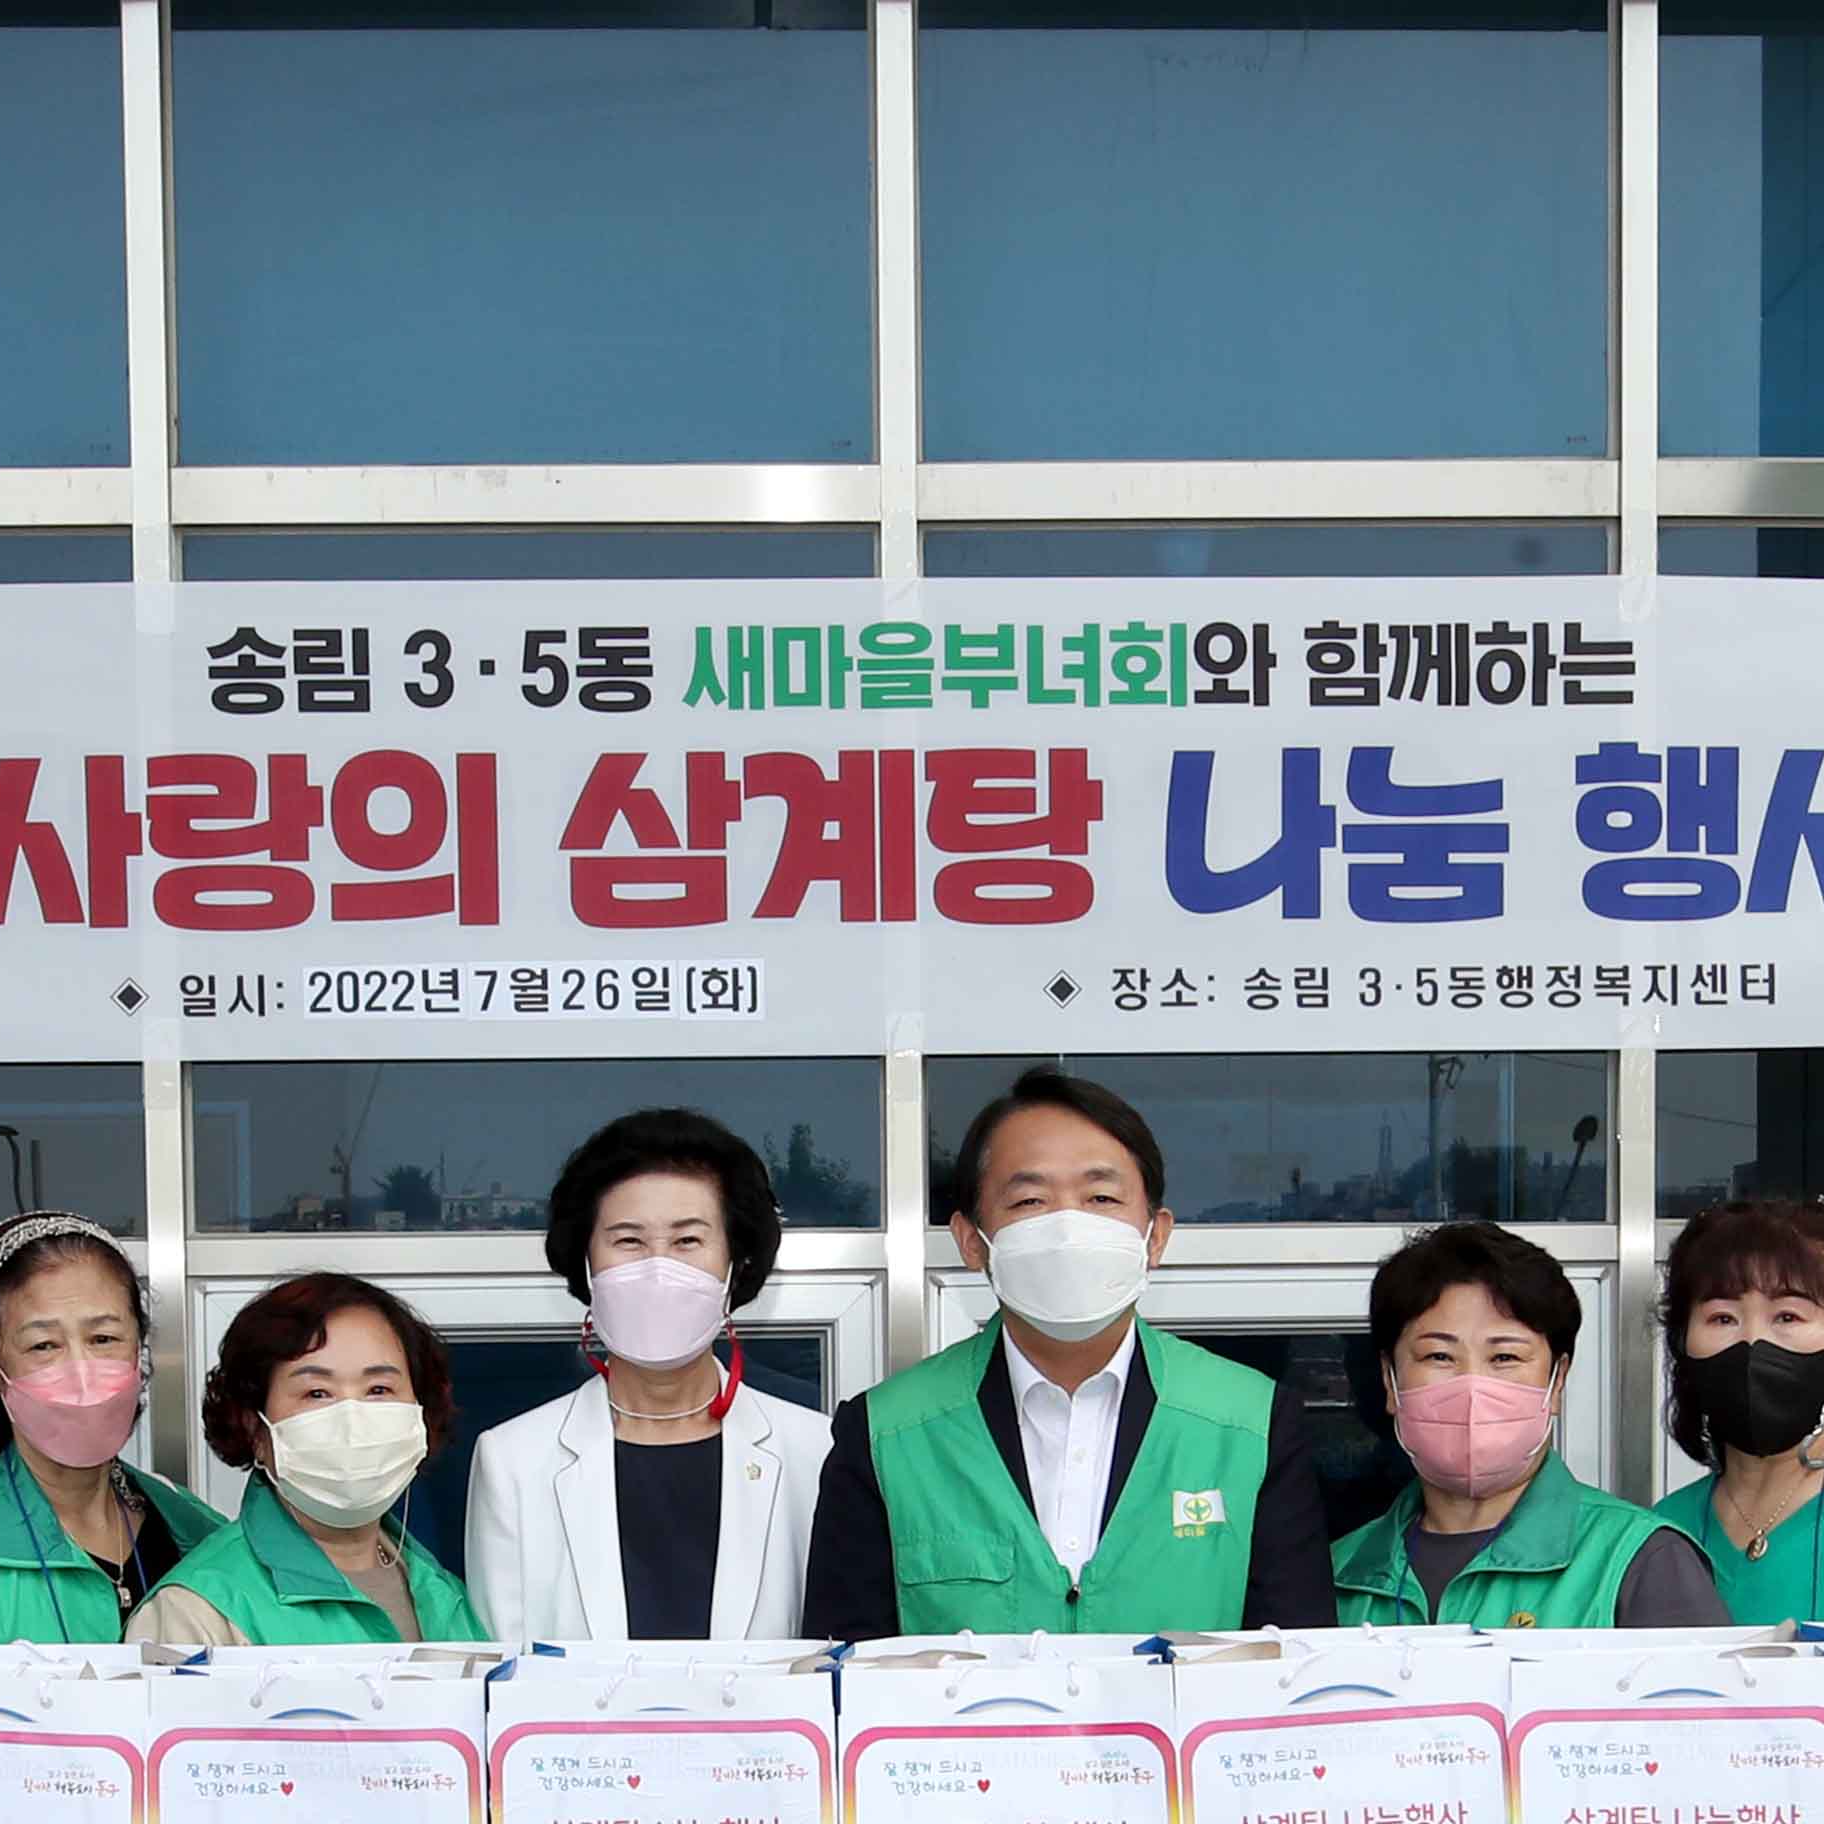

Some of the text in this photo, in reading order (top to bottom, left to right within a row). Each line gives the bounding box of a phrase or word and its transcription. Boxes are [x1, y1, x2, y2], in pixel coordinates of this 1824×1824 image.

[207, 627, 370, 714] 송림
[682, 621, 1277, 710] 새마을부녀회와
[1304, 621, 1635, 706] 함께하는
[559, 748, 1103, 928] 삼계탕
[1166, 747, 1509, 923] 나눔
[180, 975, 283, 1016] 일시:
[1112, 968, 1214, 1011] 장소:
[1244, 967, 1328, 1010] 송림
